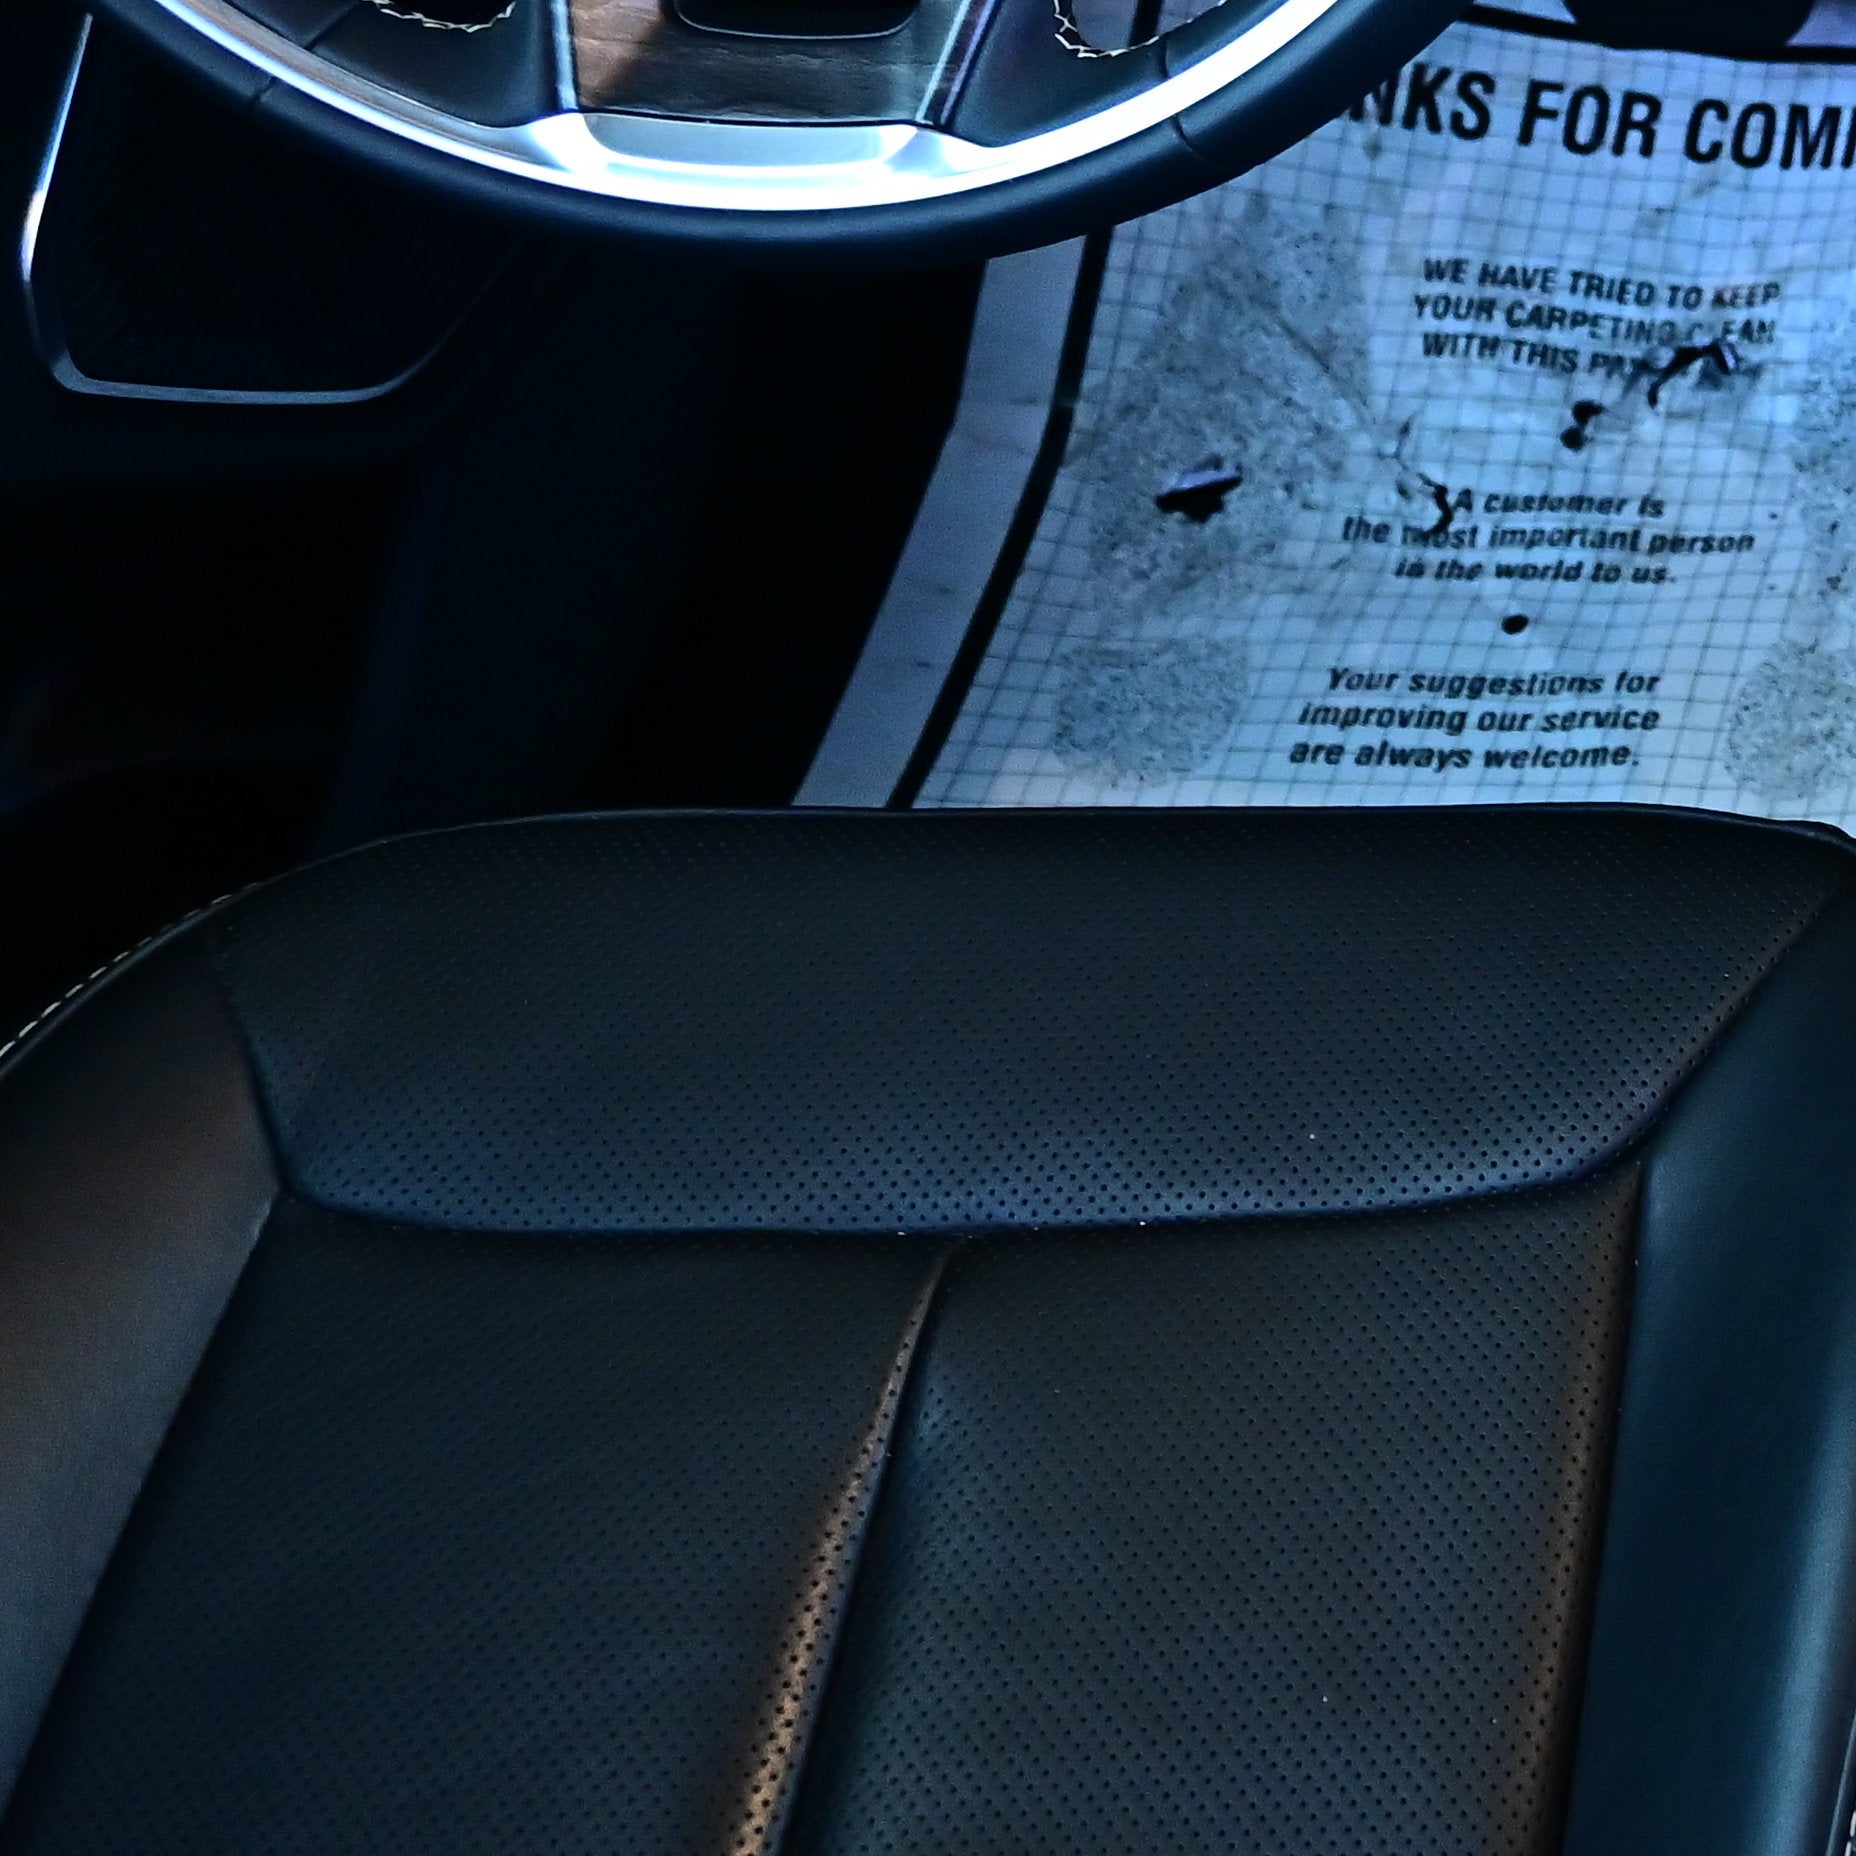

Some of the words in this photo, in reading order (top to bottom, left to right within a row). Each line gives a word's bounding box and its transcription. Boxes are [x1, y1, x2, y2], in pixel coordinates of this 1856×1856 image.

[1350, 63, 1495, 140] NKS
[1519, 80, 1664, 159] FOR
[1423, 259, 1469, 284] WE
[1478, 262, 1557, 294] HAVE
[1569, 270, 1655, 307] TRIED
[1668, 285, 1703, 310] TO
[1415, 294, 1497, 322] YOUR
[1423, 333, 1499, 358] WITH
[1511, 341, 1579, 374] THIS
[1453, 487, 1474, 513] A
[1483, 493, 1628, 515] customer
[1638, 494, 1665, 518] is
[1341, 515, 1391, 543] the
[1489, 525, 1641, 552] important
[1648, 532, 1756, 556] person
[1395, 557, 1425, 579] in
[1434, 558, 1484, 580] the
[1494, 559, 1583, 582] world
[1590, 561, 1622, 583] to
[1328, 667, 1400, 692] Your
[1408, 670, 1604, 699] suggestions
[1615, 669, 1661, 694] for
[1299, 702, 1469, 736] improving
[1477, 709, 1534, 732] our
[1542, 704, 1661, 732] service
[1290, 742, 1346, 764] are
[1354, 740, 1472, 773] always
[1482, 744, 1640, 769] welcome.
